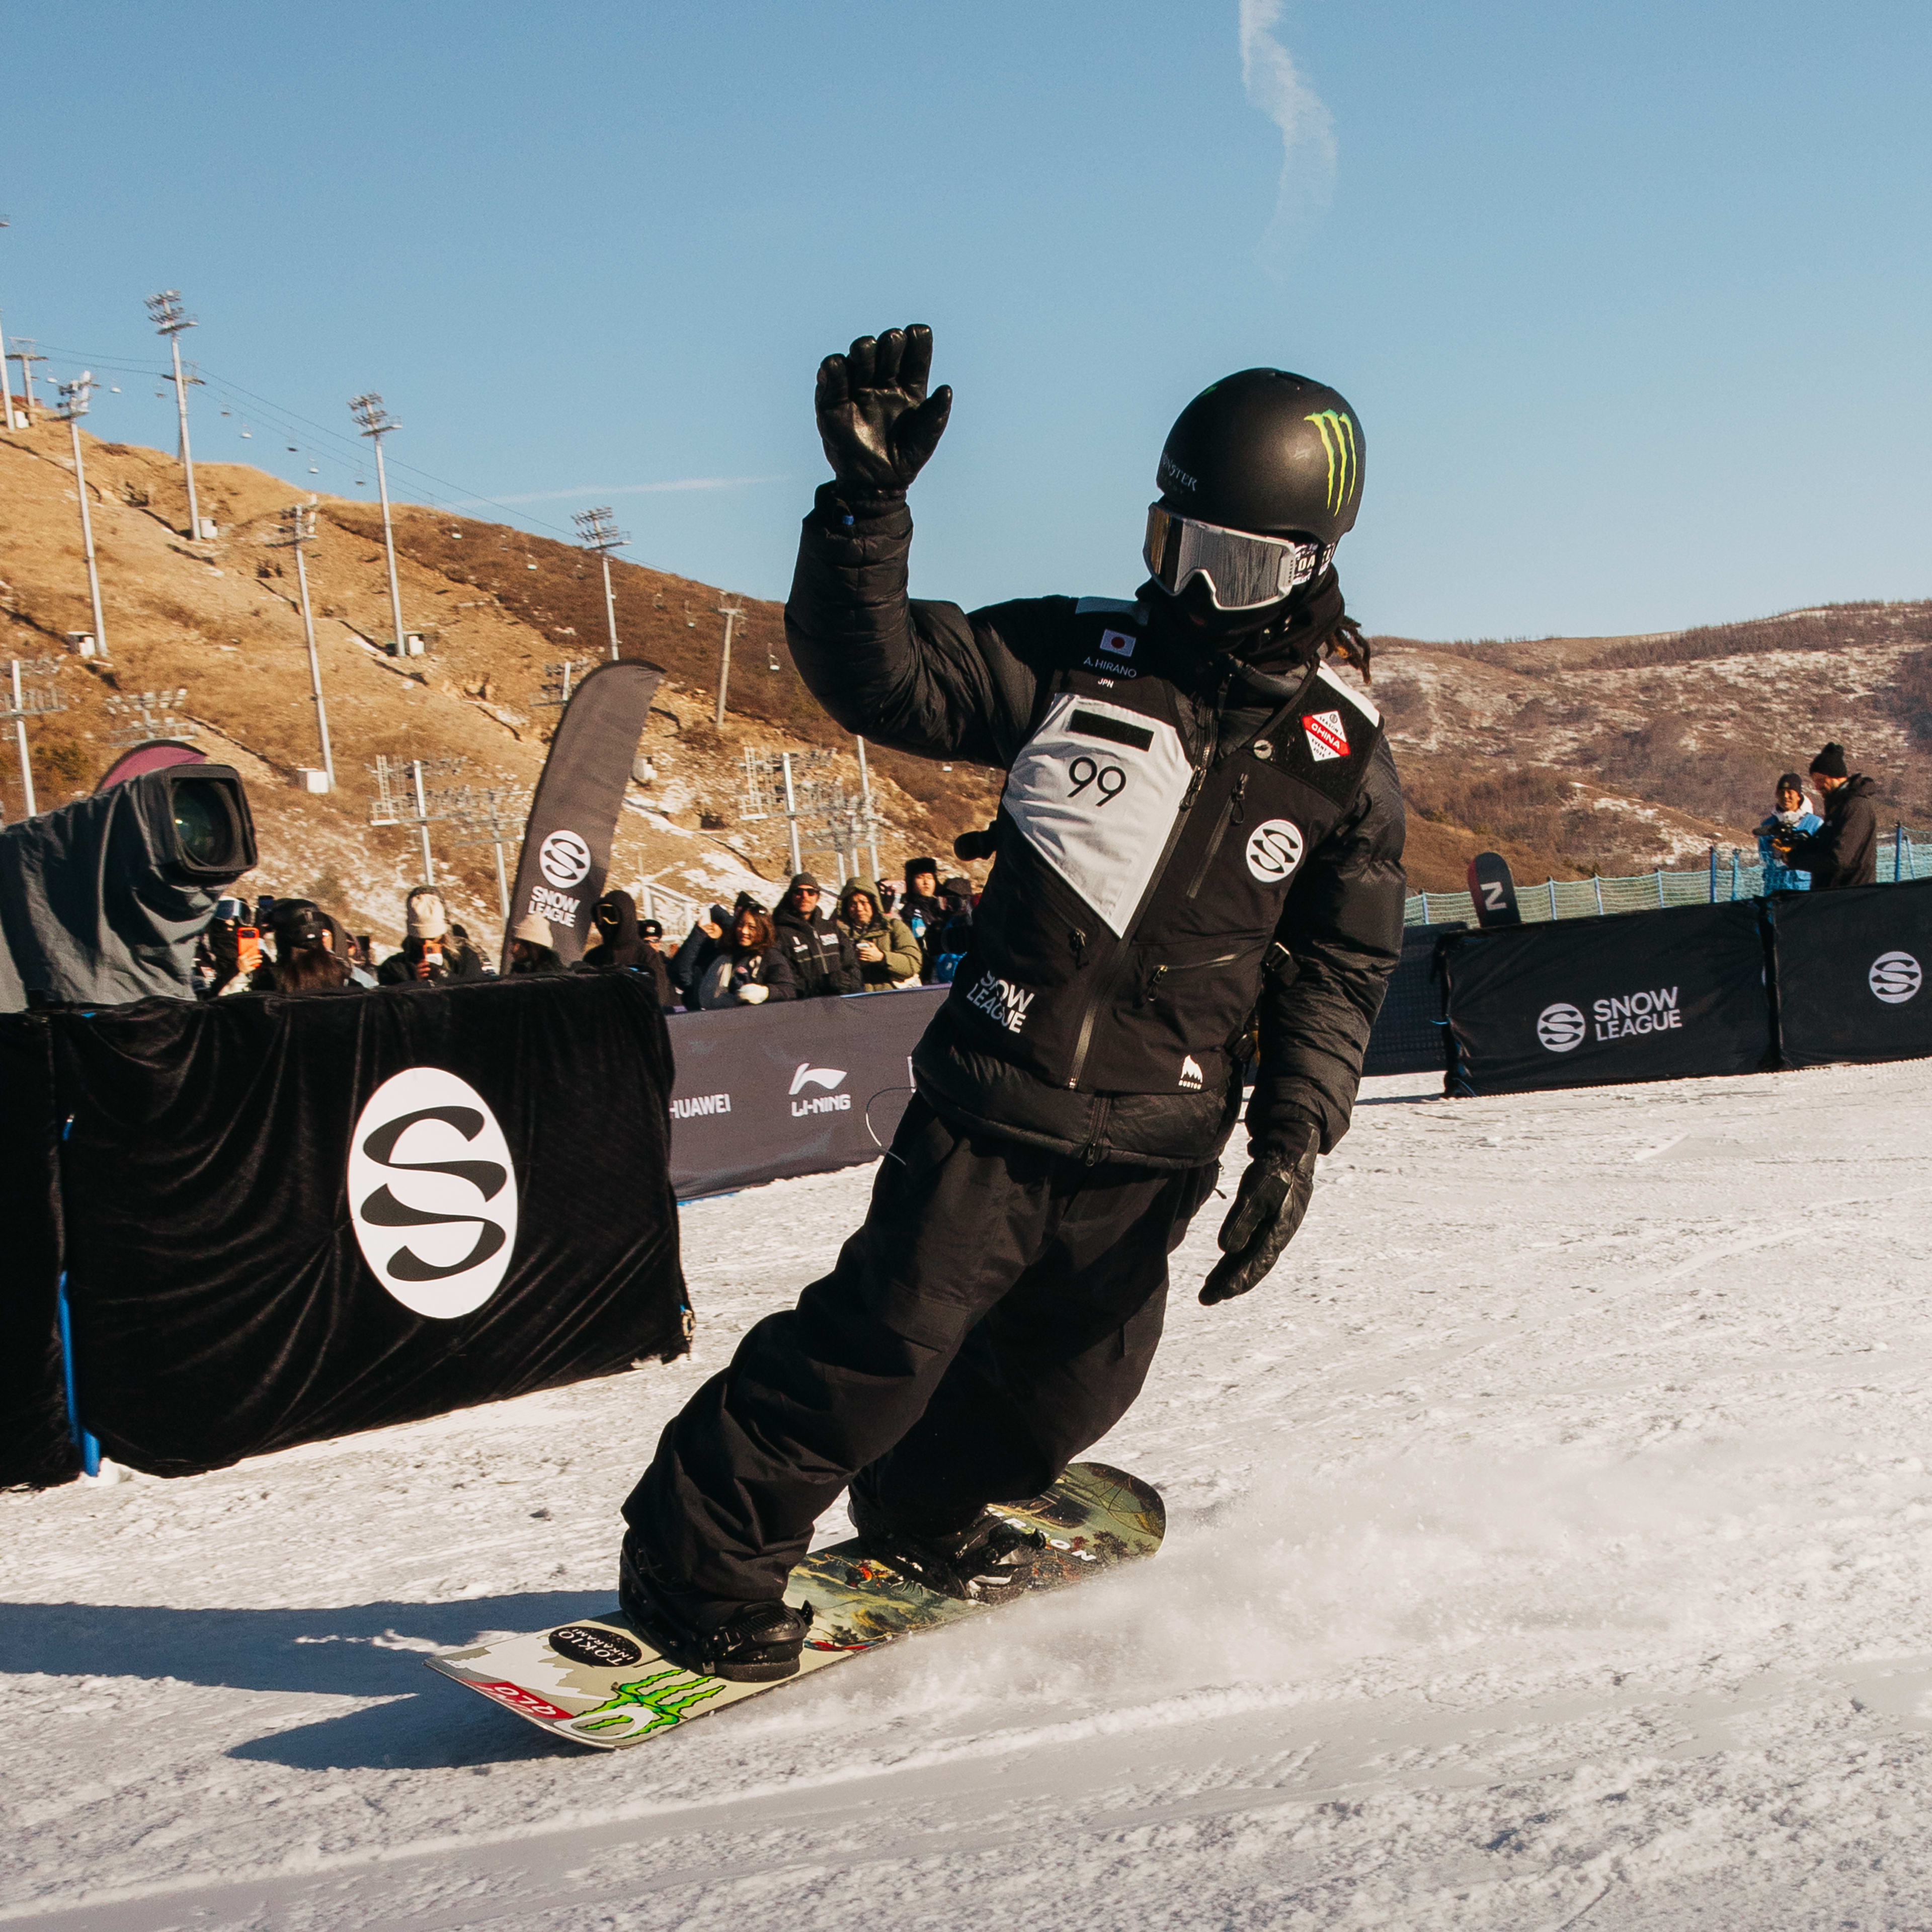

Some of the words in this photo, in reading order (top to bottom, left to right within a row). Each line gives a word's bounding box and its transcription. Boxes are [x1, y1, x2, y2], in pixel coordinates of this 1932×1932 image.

[1097, 677, 1114, 688] JPN
[1311, 723, 1340, 750] CHINA
[1067, 756, 1126, 808] 99
[531, 886, 581, 913] SNOW
[528, 900, 577, 928] LEAGUE
[966, 983, 1026, 1033] LEAGUE
[1593, 986, 1678, 1022] SNOW
[1595, 1009, 1683, 1041] LEAGUE
[669, 1093, 731, 1119] HUAWEI
[558, 1631, 623, 1666] TOKIO
[494, 1687, 556, 1715] QLO
